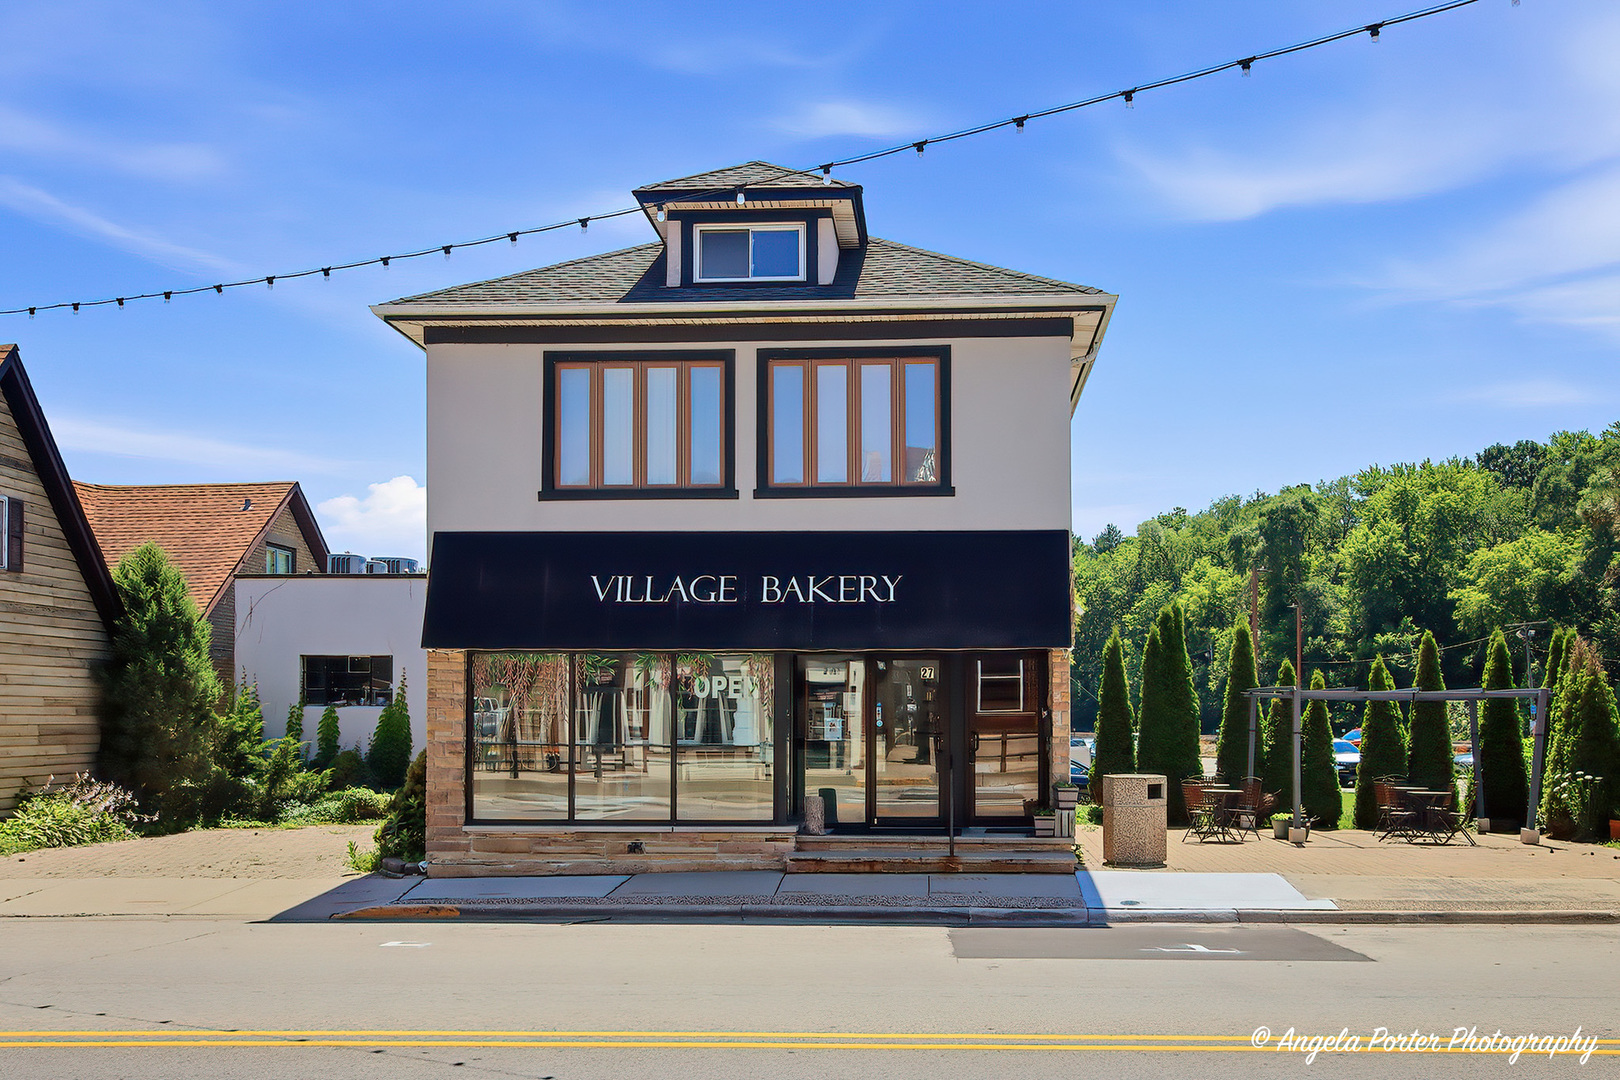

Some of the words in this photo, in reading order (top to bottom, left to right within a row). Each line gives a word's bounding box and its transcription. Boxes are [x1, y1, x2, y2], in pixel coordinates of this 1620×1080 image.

[590, 575, 738, 603] VILLAGE
[760, 575, 903, 603] BAKERY
[921, 667, 934, 678] 27
